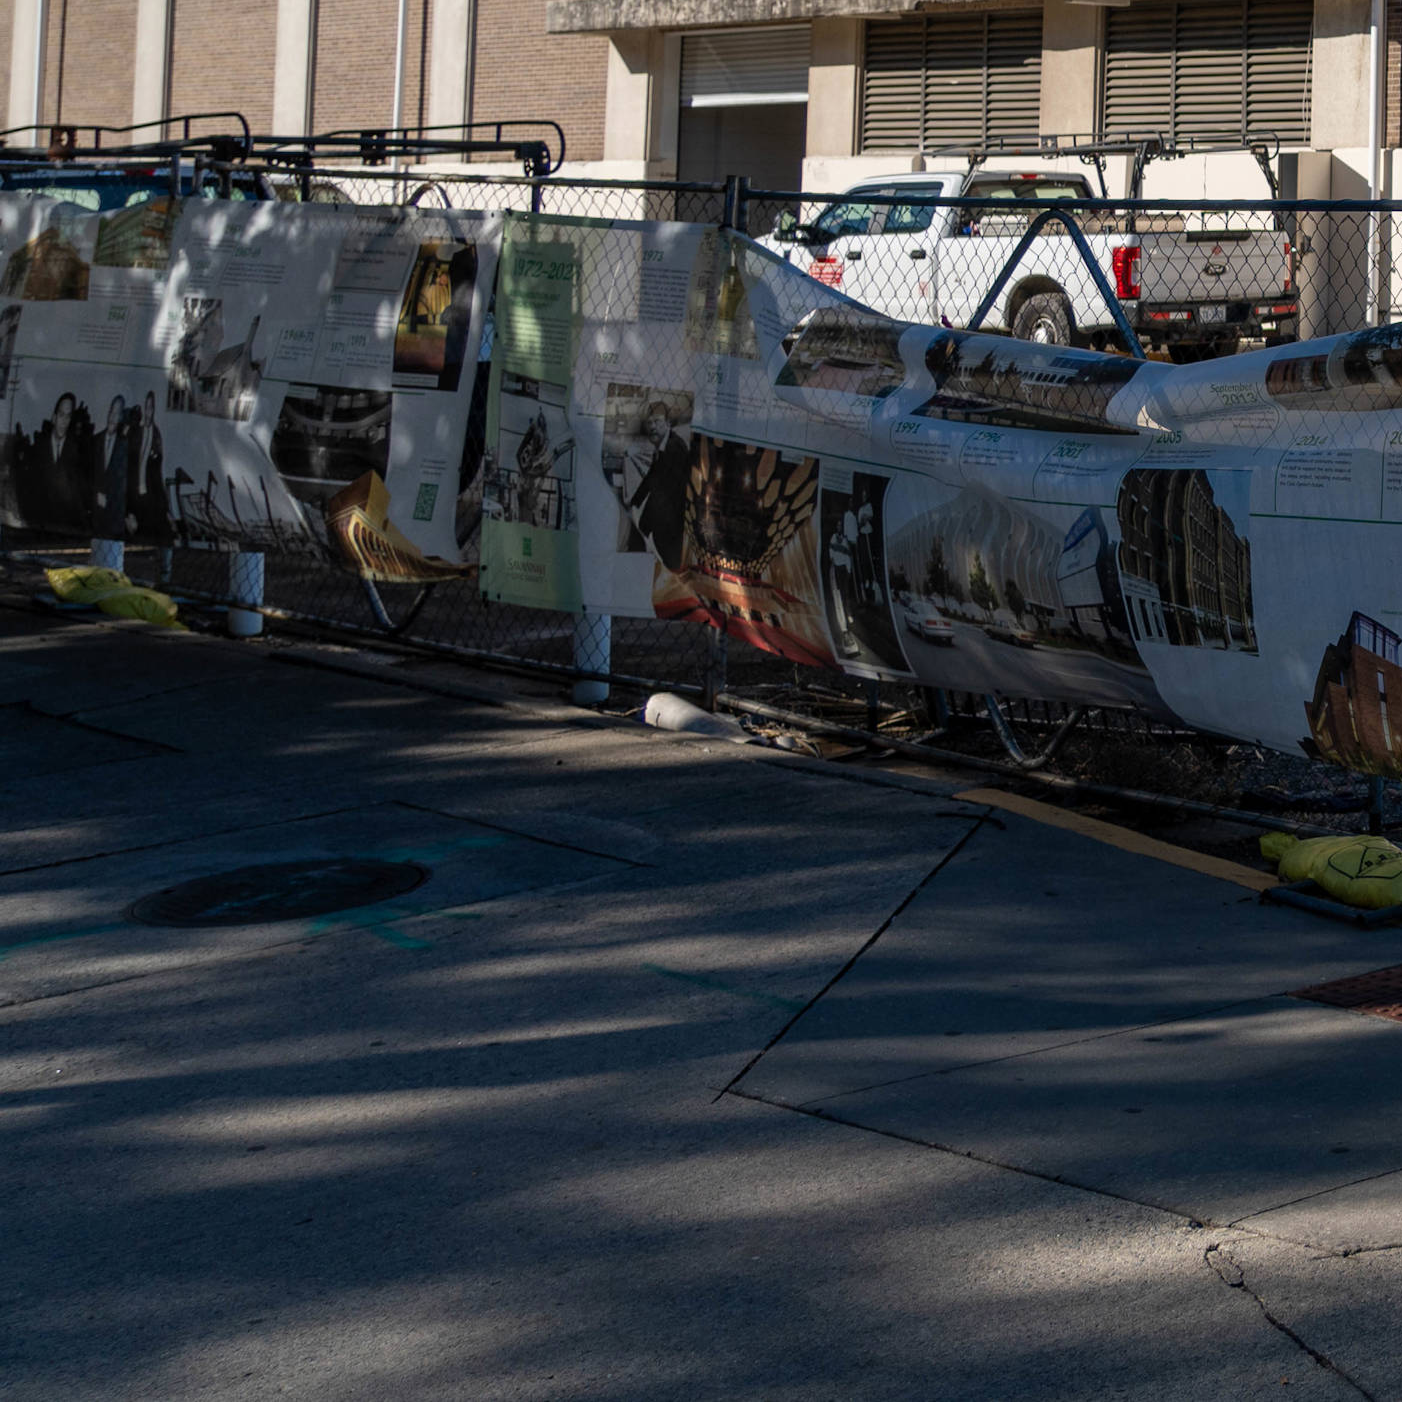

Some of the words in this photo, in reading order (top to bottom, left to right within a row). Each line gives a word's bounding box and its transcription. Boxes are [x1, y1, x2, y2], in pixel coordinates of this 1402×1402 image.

[1210, 383, 1252, 396] September
[895, 422, 921, 433] 1991
[1156, 430, 1182, 444] 2005
